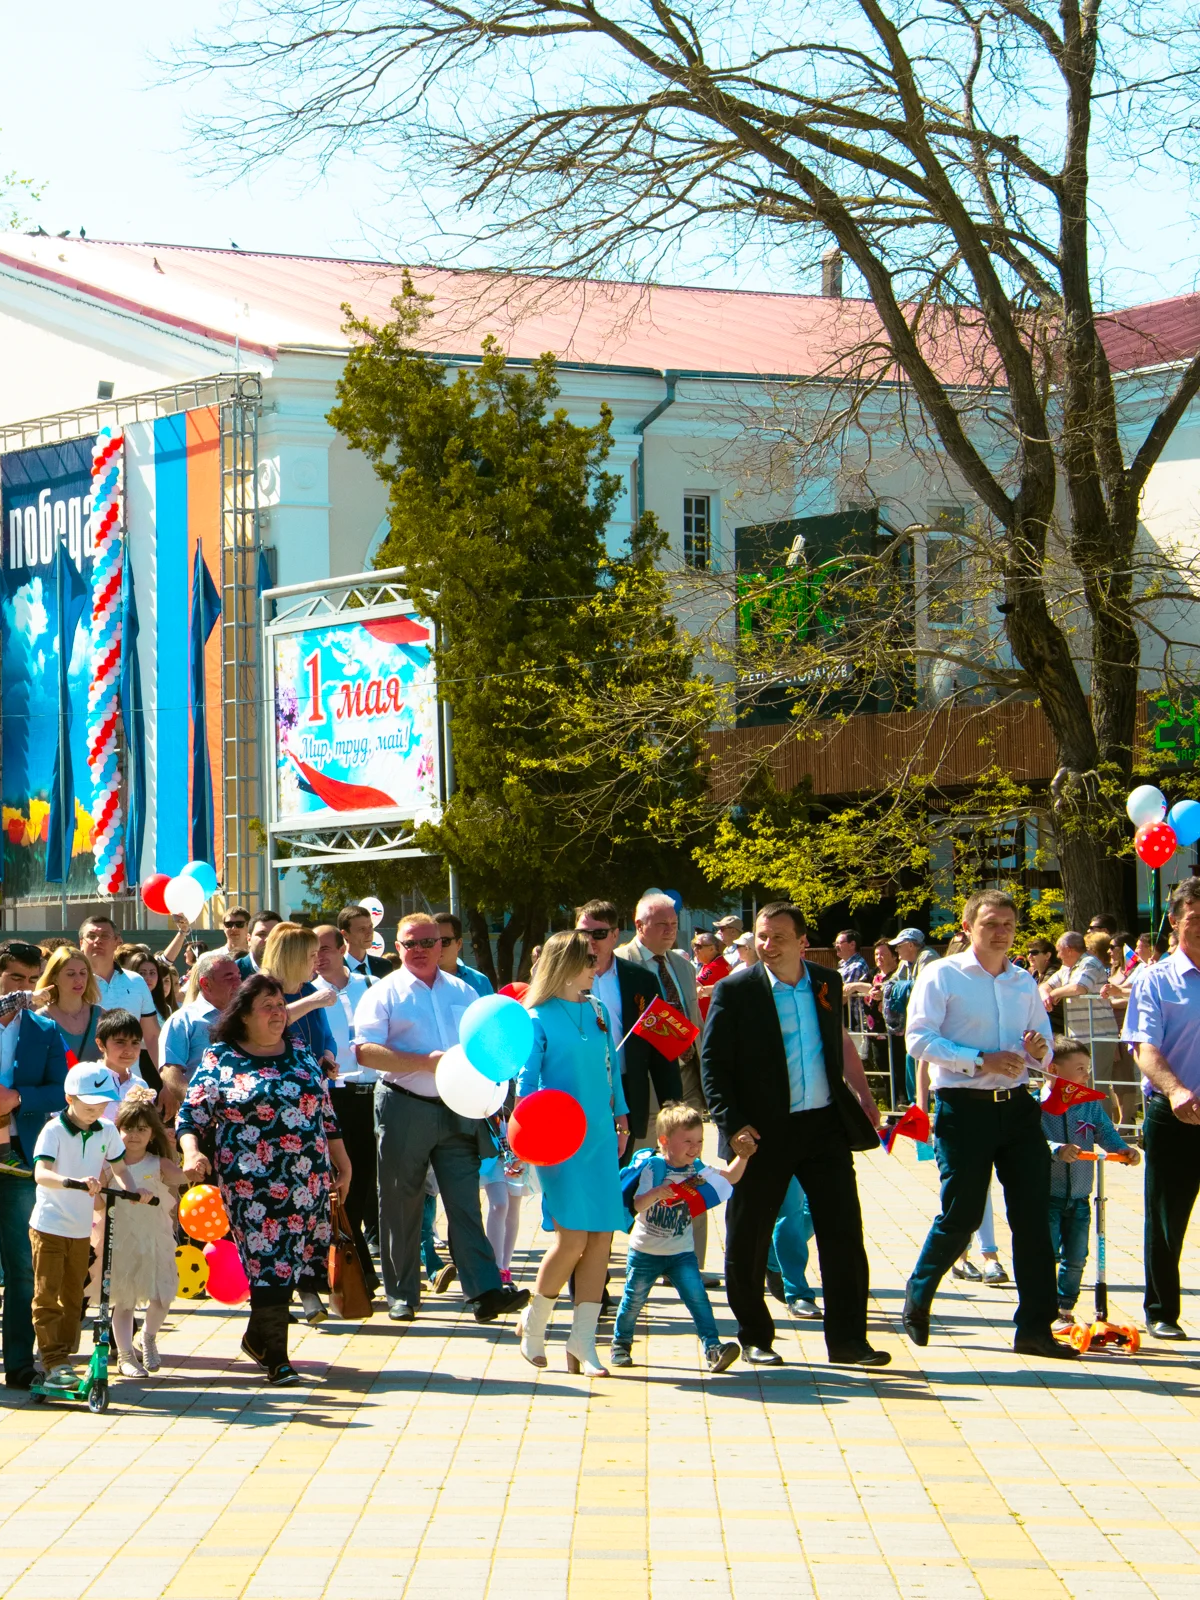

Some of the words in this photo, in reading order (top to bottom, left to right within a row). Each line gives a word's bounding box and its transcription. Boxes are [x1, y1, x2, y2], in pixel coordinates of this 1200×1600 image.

[9, 487, 95, 574] победа
[306, 653, 324, 721] 1
[336, 677, 404, 720] мая
[299, 737, 332, 767] Мир,
[334, 737, 372, 765] труд,
[376, 725, 409, 751] май!
